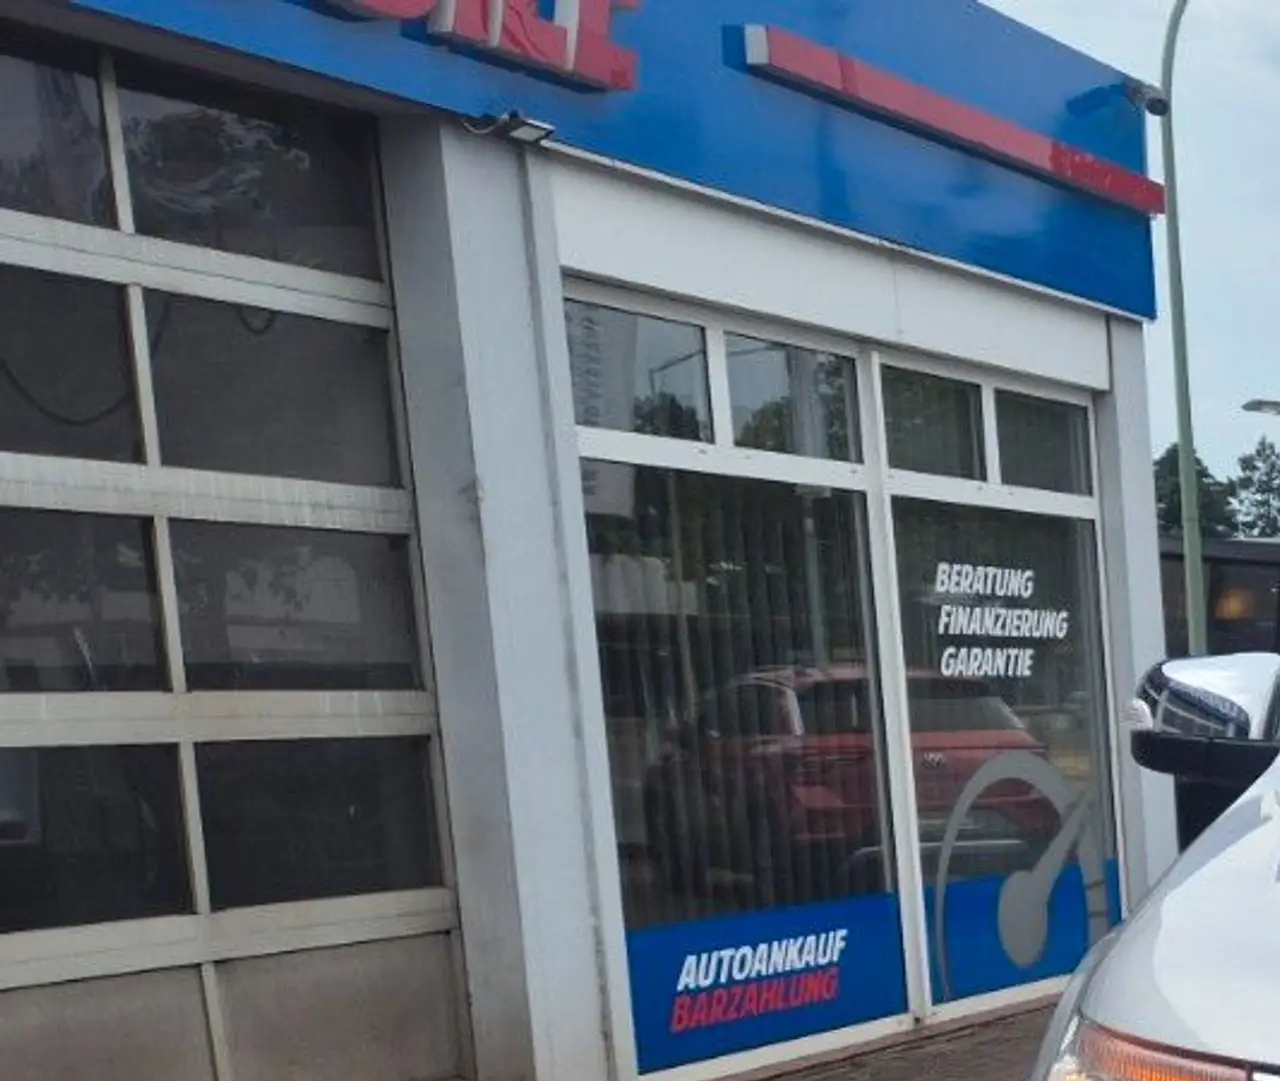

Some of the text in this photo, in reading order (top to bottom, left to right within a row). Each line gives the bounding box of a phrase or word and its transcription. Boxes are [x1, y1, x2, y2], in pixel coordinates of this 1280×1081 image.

[935, 562, 1034, 598] BERATUNG
[938, 605, 1069, 639] FINANZIERUNG
[940, 647, 1034, 678] GARANTIE
[676, 928, 848, 992] AUTOANKAUF
[669, 967, 840, 1034] BARZAHLUNG
